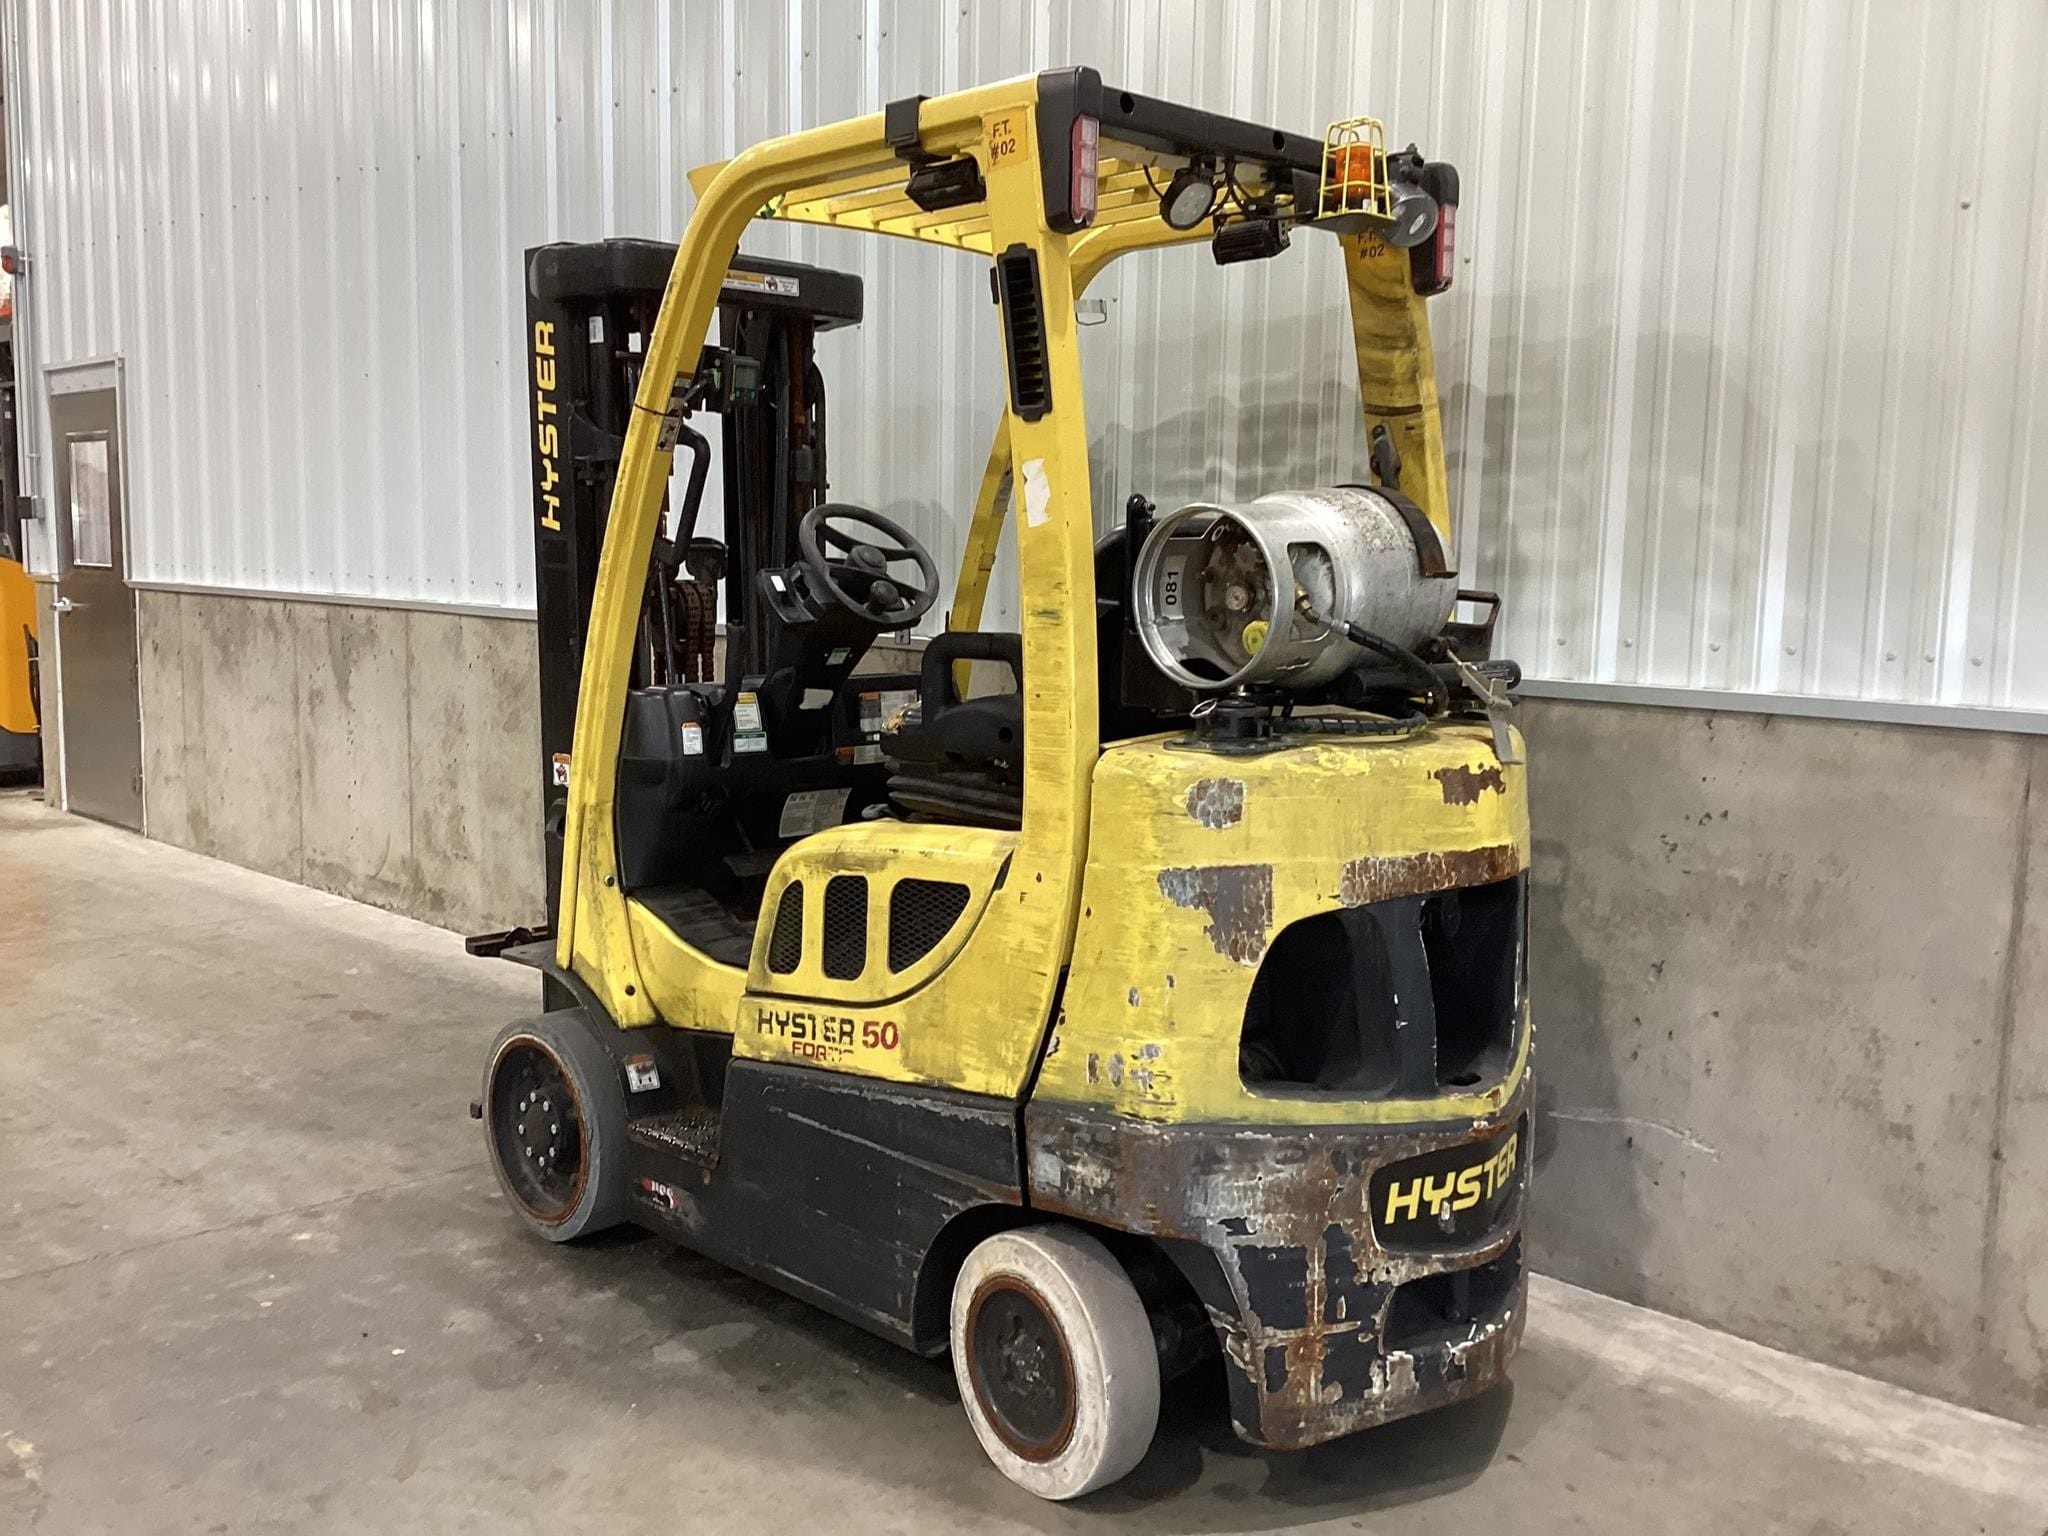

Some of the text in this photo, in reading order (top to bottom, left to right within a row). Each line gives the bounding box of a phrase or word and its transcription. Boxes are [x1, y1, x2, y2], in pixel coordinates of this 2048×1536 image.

[992, 119, 1012, 139] F.T.
[990, 137, 1016, 166] #02
[1360, 243, 1385, 260] #02
[534, 320, 561, 531] HYSTER
[1165, 571, 1179, 606] 081
[862, 1020, 900, 1050] 50
[1384, 1132, 1518, 1225] HYSTER
